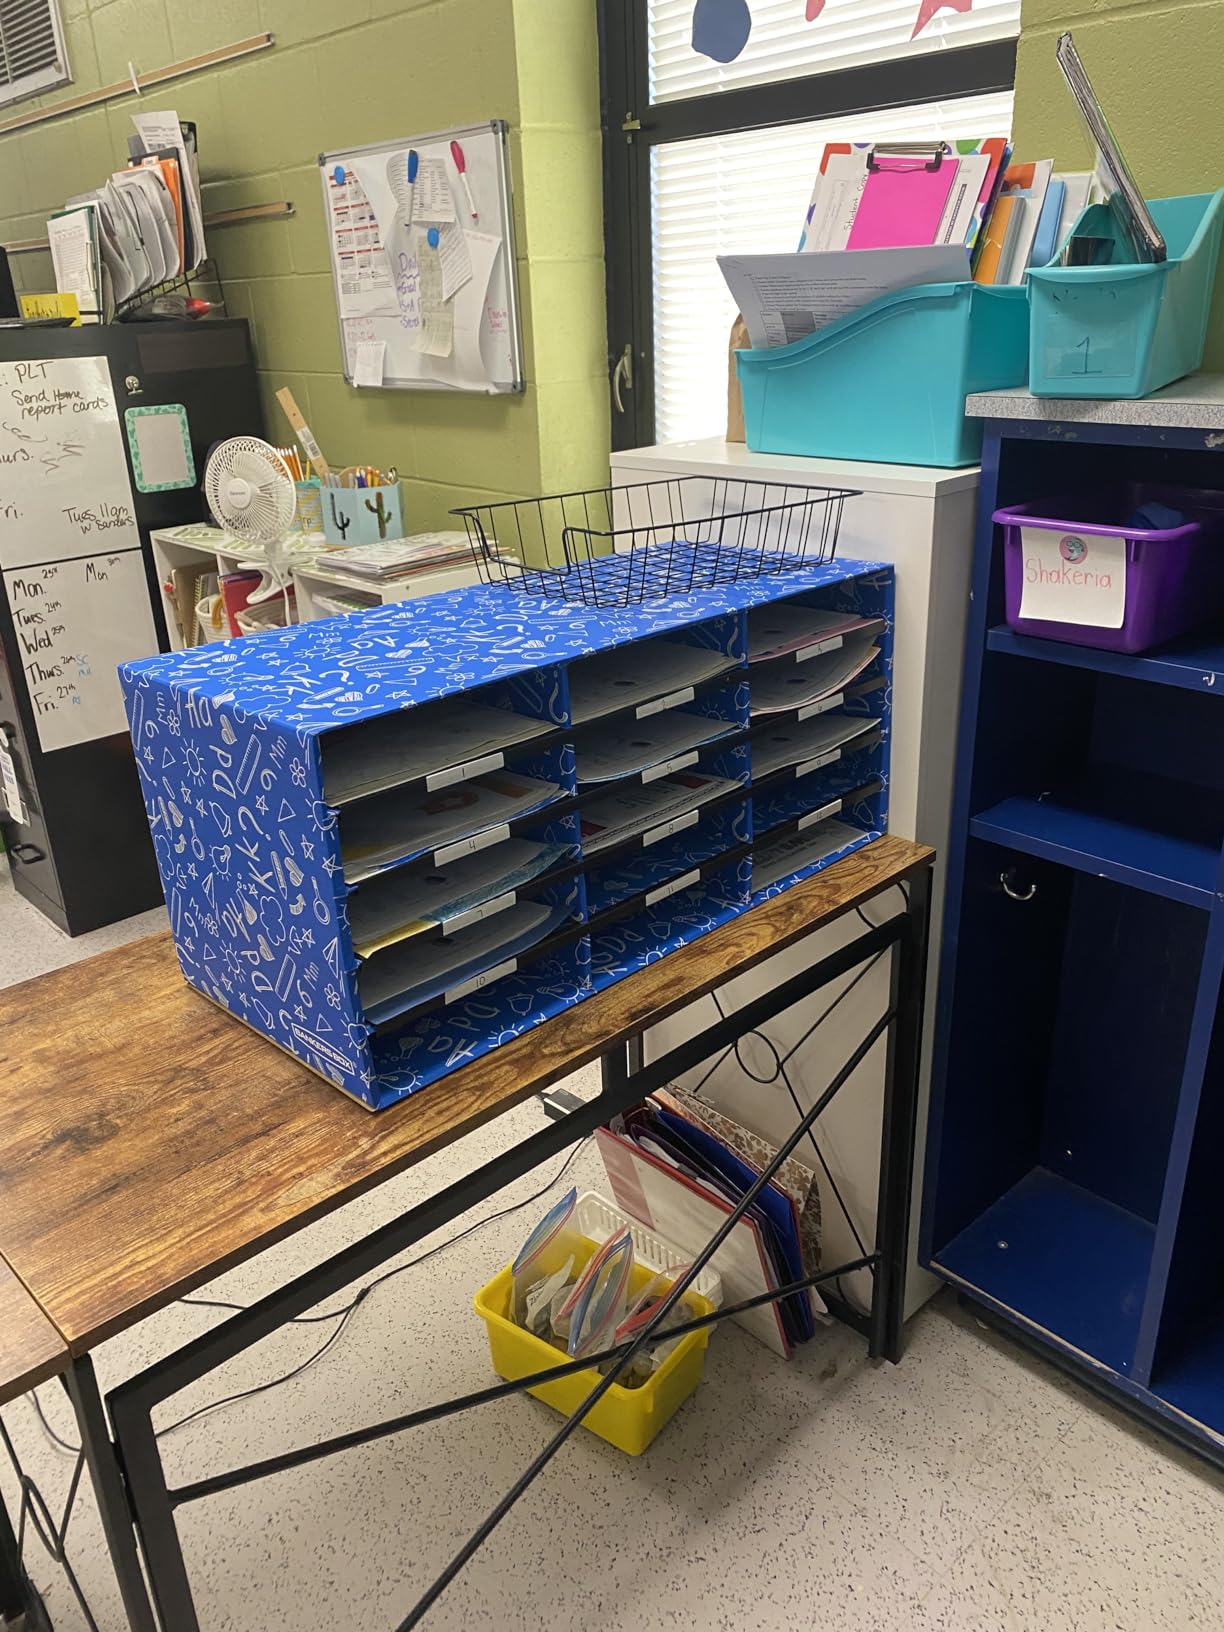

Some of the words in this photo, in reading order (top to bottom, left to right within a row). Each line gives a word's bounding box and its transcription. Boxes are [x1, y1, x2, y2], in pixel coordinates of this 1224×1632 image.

[1071, 335, 1102, 375] 1
[15, 361, 54, 384] PLT
[11, 389, 50, 406] Send
[22, 404, 67, 421] report
[73, 397, 109, 413] cards
[0, 448, 34, 463] urs.
[0, 499, 23, 519] ri.
[86, 562, 109, 583] Mon
[1025, 558, 1112, 589] Shakeria
[294, 1027, 333, 1058] BANKERS
